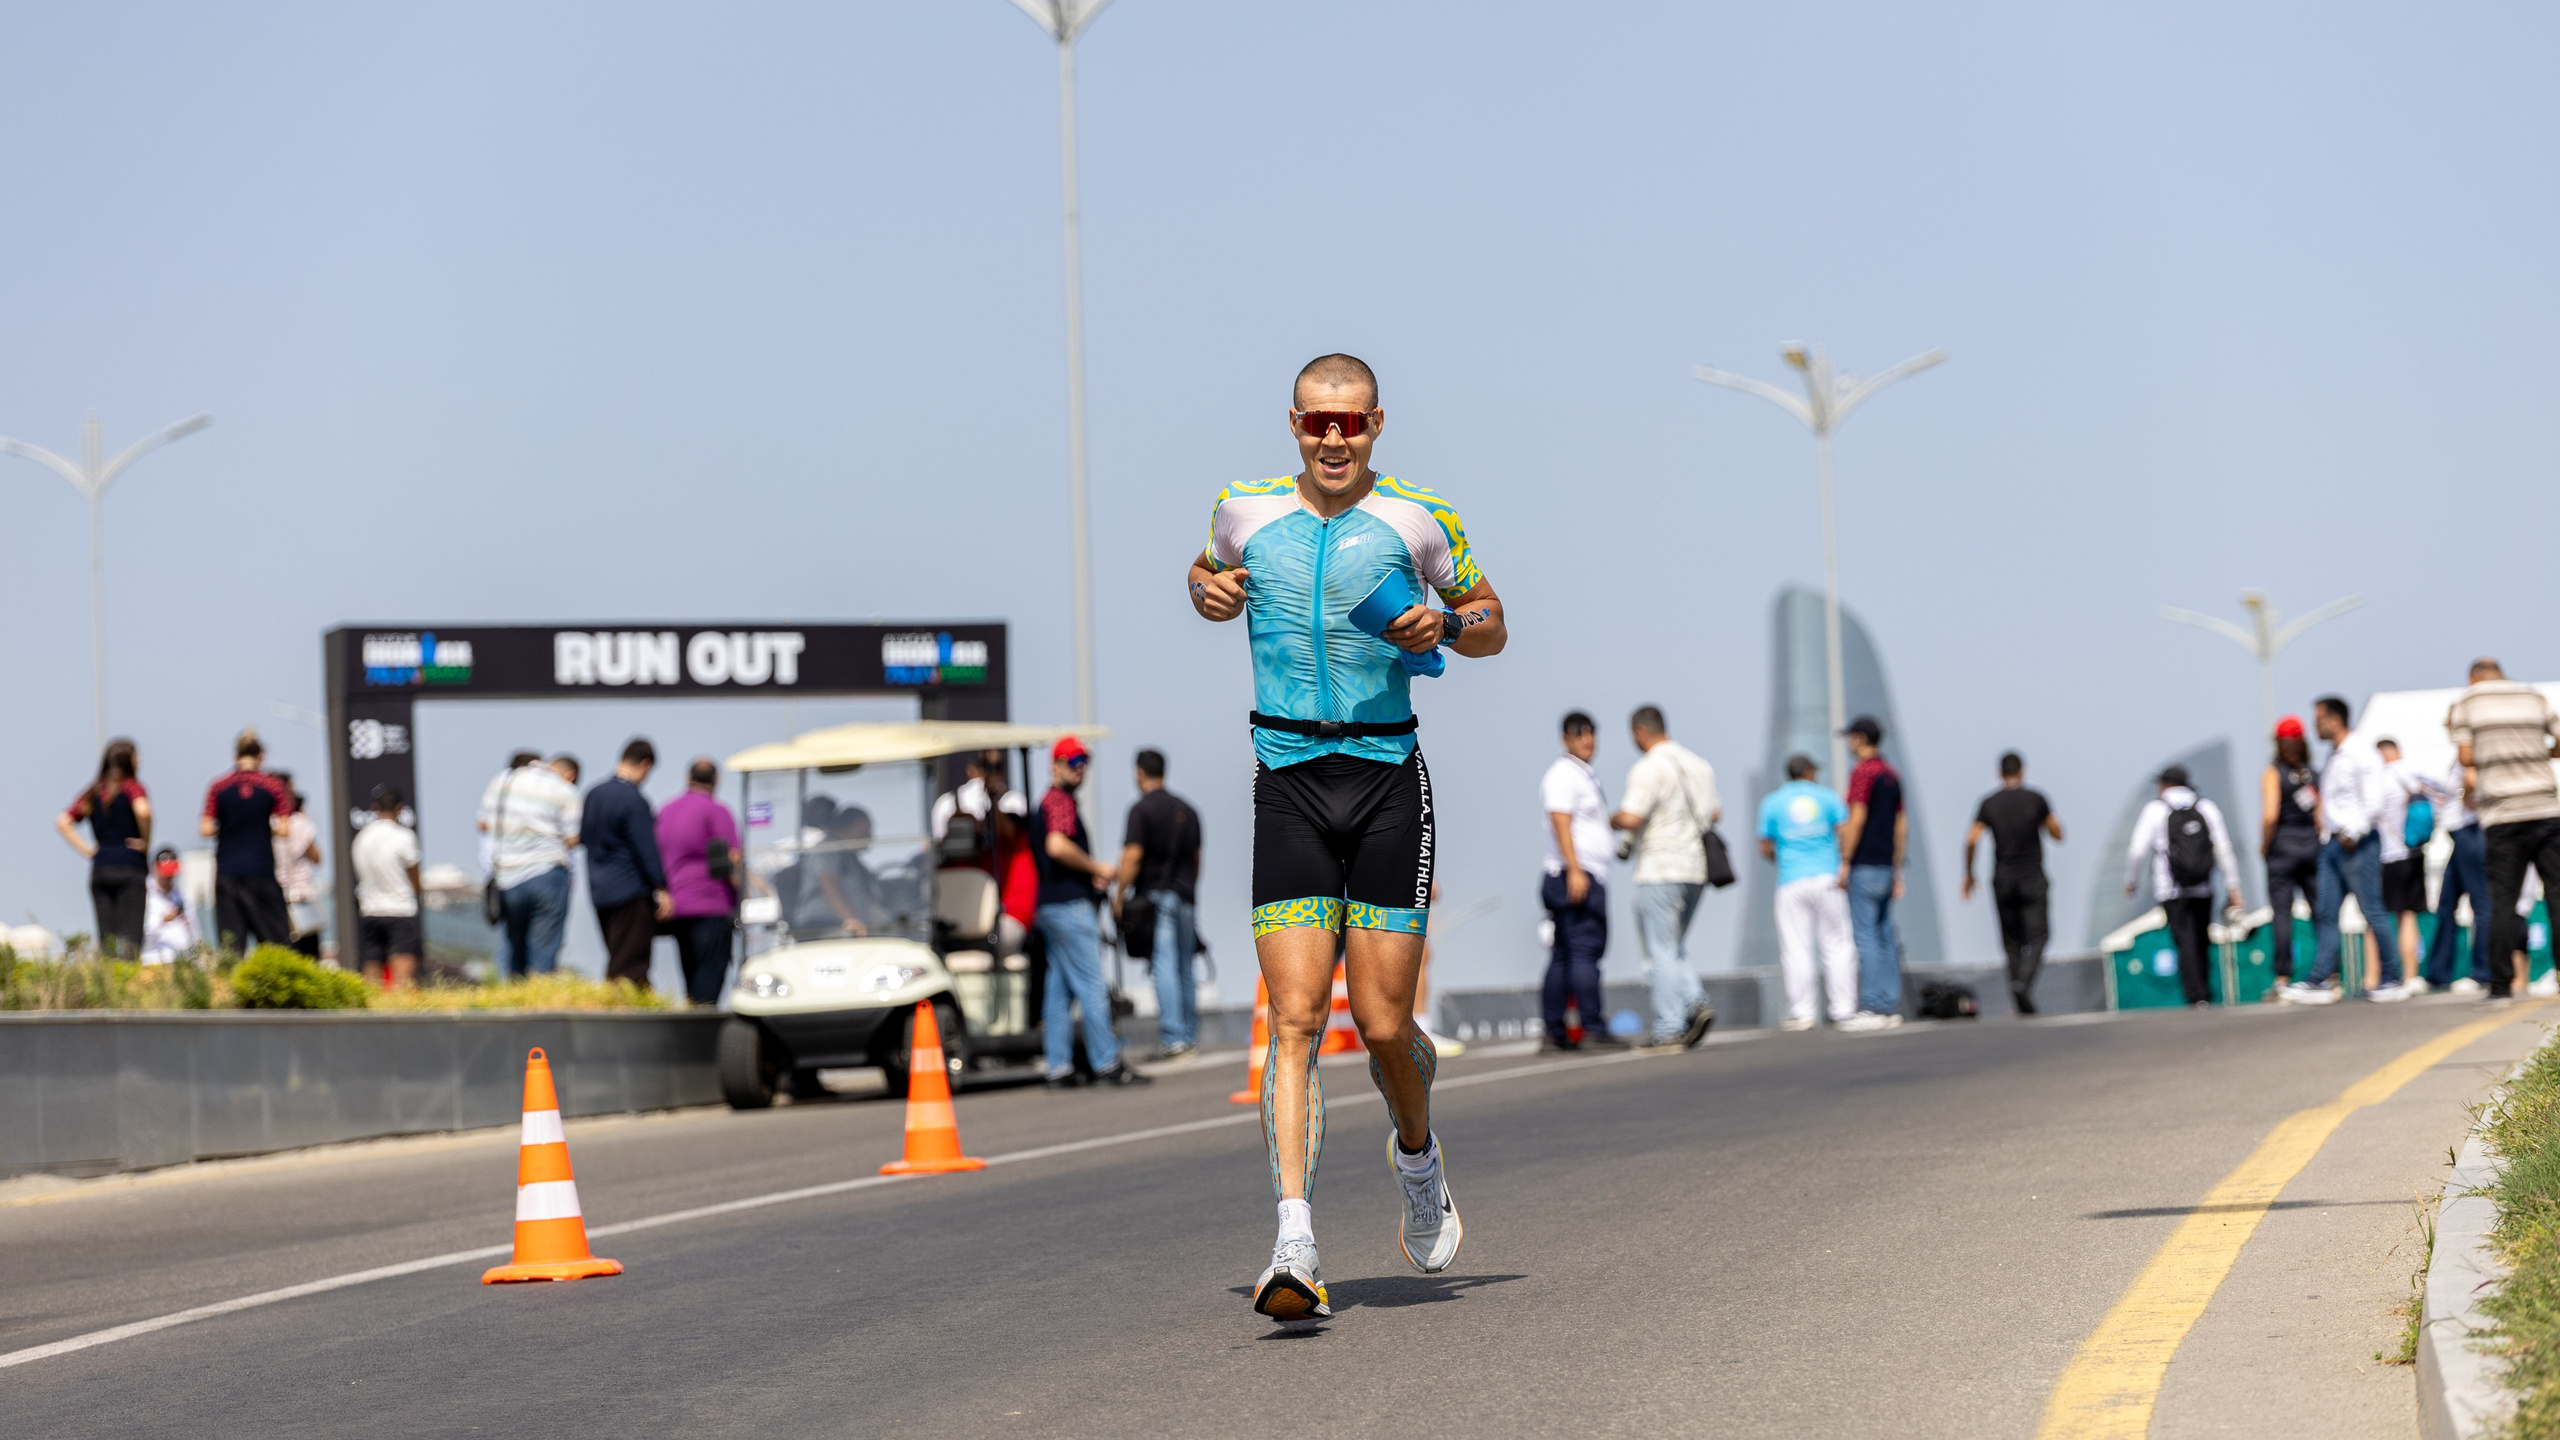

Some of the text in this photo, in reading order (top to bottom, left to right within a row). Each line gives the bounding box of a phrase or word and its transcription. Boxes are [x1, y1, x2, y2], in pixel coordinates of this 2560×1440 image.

[554, 631, 806, 686] RUN OUT
[1414, 750, 1432, 909] VANILLA_TRIATHLON
